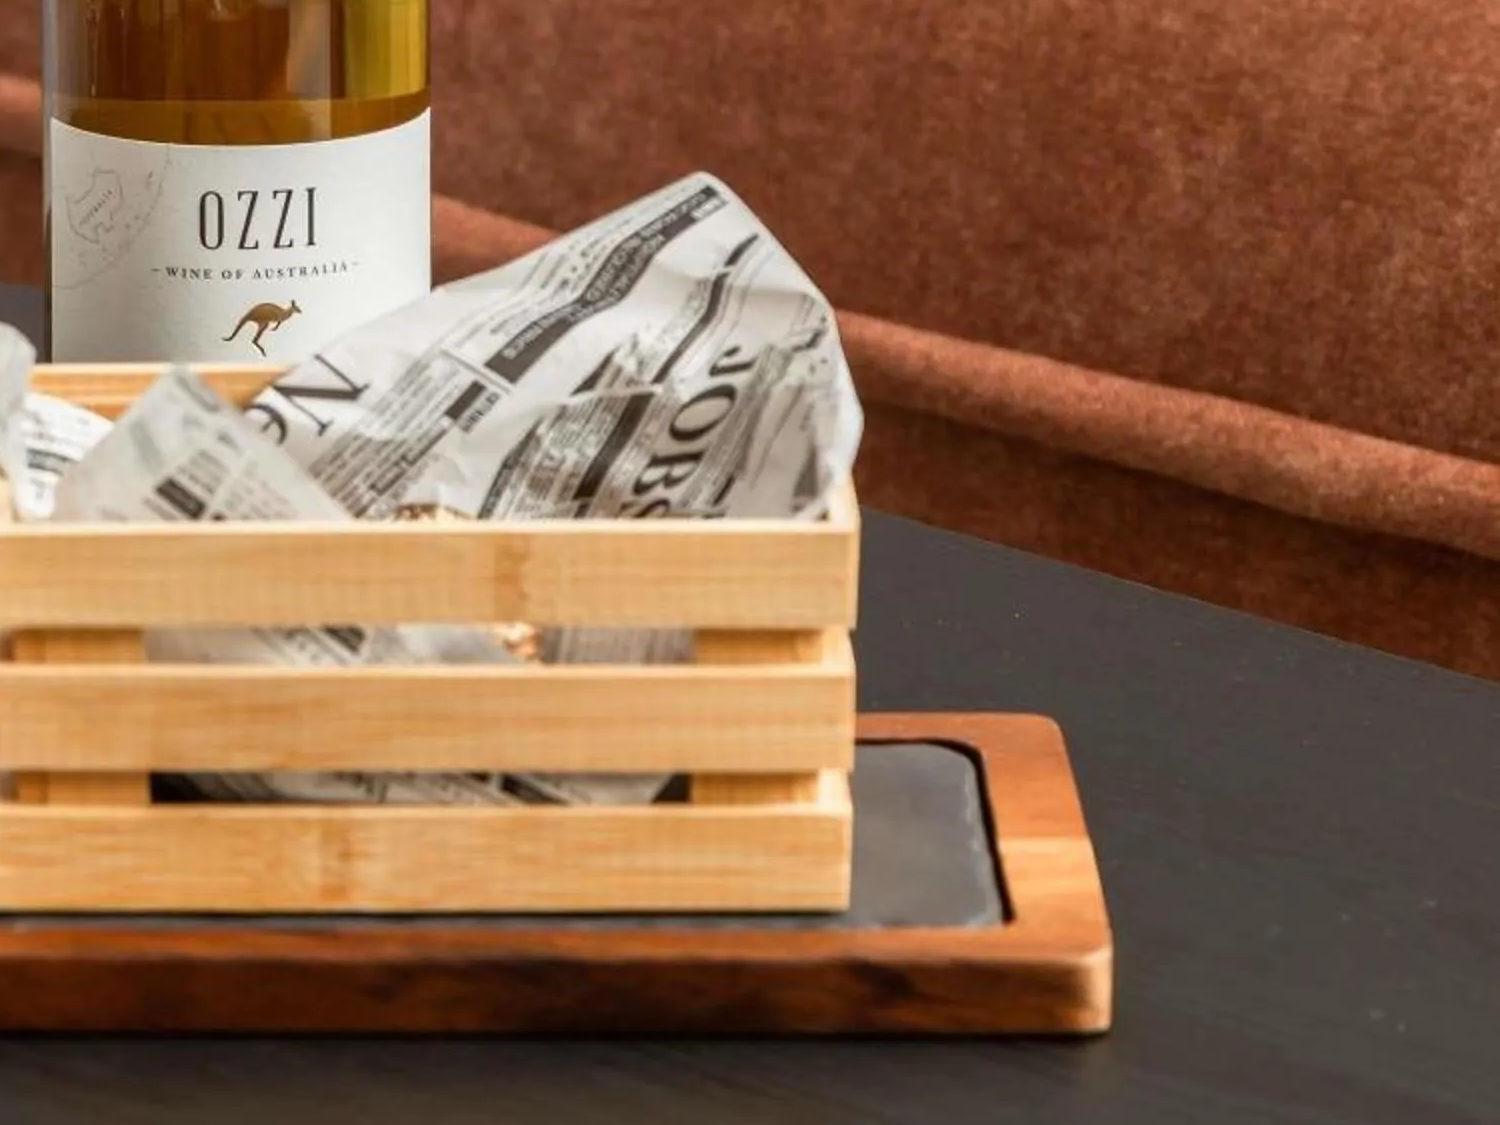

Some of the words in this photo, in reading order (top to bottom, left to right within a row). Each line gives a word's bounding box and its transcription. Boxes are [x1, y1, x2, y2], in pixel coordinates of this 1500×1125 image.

[197, 186, 318, 251] OZZI
[164, 265, 213, 281] WINE
[219, 267, 245, 282] OF
[251, 260, 349, 281] AUSTRALIA
